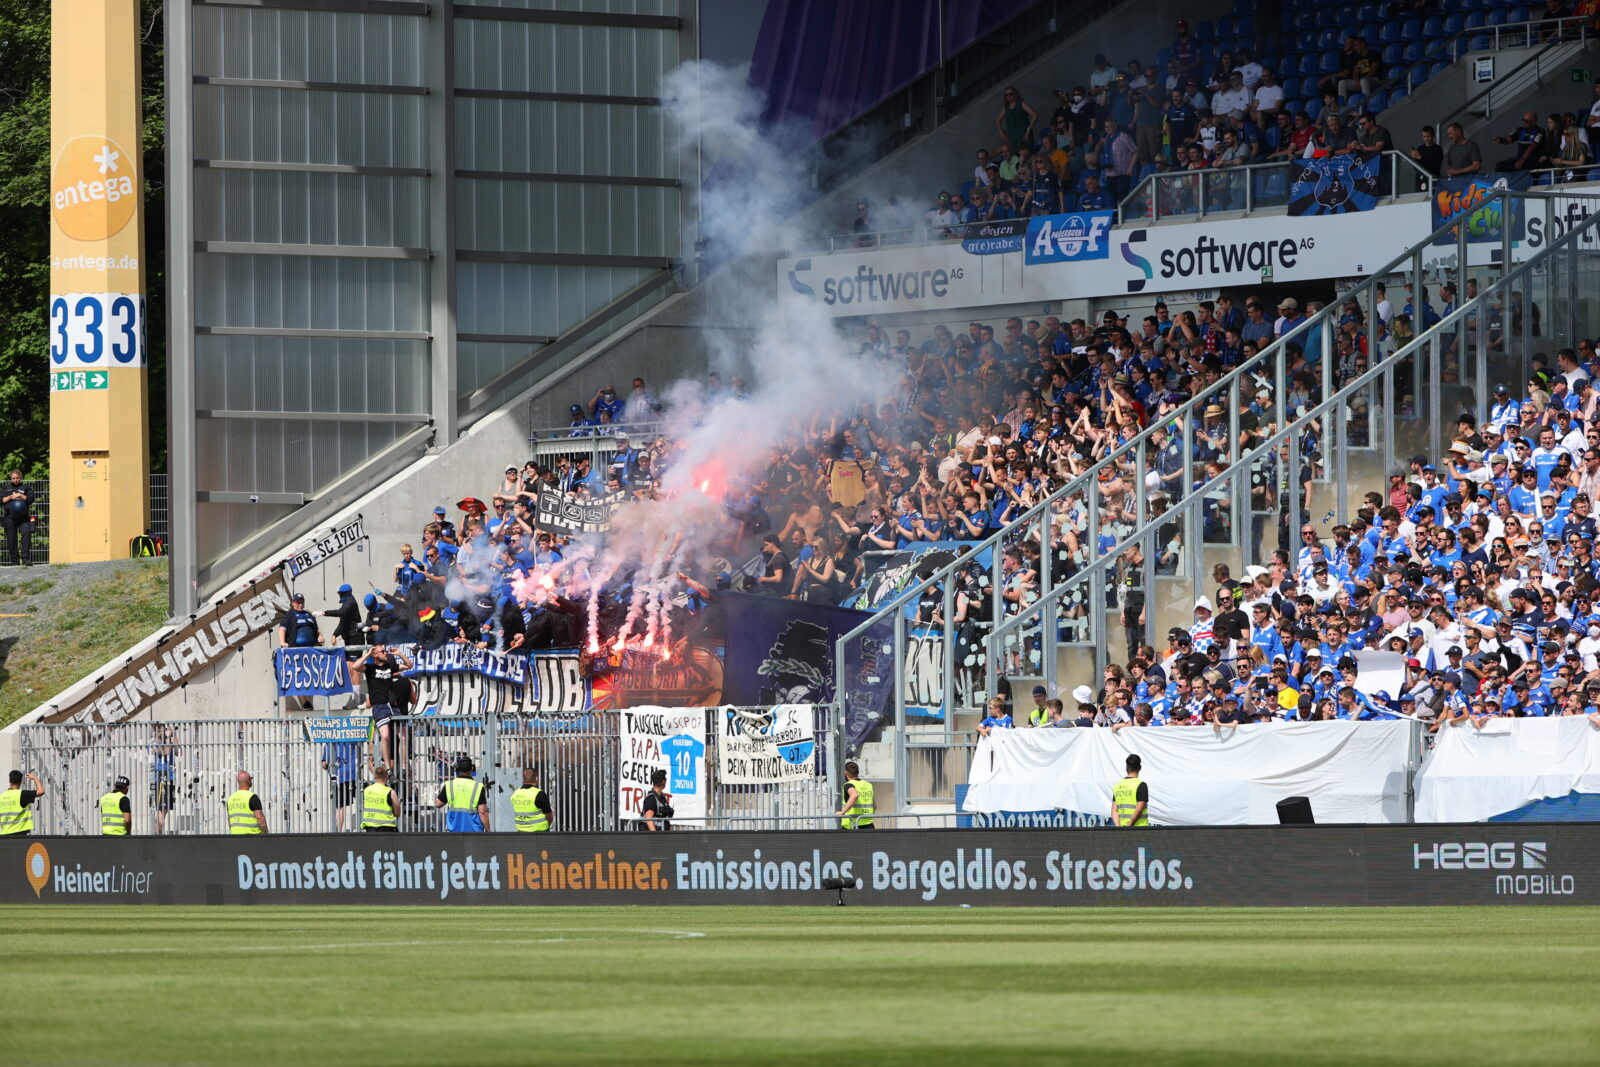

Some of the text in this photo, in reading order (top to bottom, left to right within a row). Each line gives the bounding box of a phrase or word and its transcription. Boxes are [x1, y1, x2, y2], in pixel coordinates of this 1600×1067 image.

[54, 174, 133, 211] entega
[979, 225, 1014, 236] Gegen
[1032, 215, 1110, 257] A F
[1051, 228, 1083, 240] PADERBORN
[1069, 219, 1077, 228] SC
[1527, 202, 1600, 248] soft
[61, 255, 139, 271] entega.de
[1160, 234, 1315, 278] software AG
[824, 265, 964, 305] software AG
[295, 521, 360, 570] PB SC 1907
[281, 653, 344, 690] GESSELN
[308, 717, 341, 728] SCHNAPS
[349, 717, 370, 727] WEED
[624, 712, 667, 736] TAUSCHE
[787, 710, 798, 726] SC
[631, 737, 660, 762] PAPA
[788, 747, 800, 761] 07
[621, 760, 658, 785] GEGEN
[675, 751, 691, 777] 10
[727, 758, 748, 778] DEIN
[750, 756, 783, 779] TRIKOT
[621, 787, 673, 814] TRT
[53, 863, 154, 894] HeinerLiner
[237, 846, 1194, 901] Darmstadt fährt jetzt HeinerLiner. Emissionslos. Bargeldlos. Stresslos.
[1495, 873, 1575, 895] MOBILO
